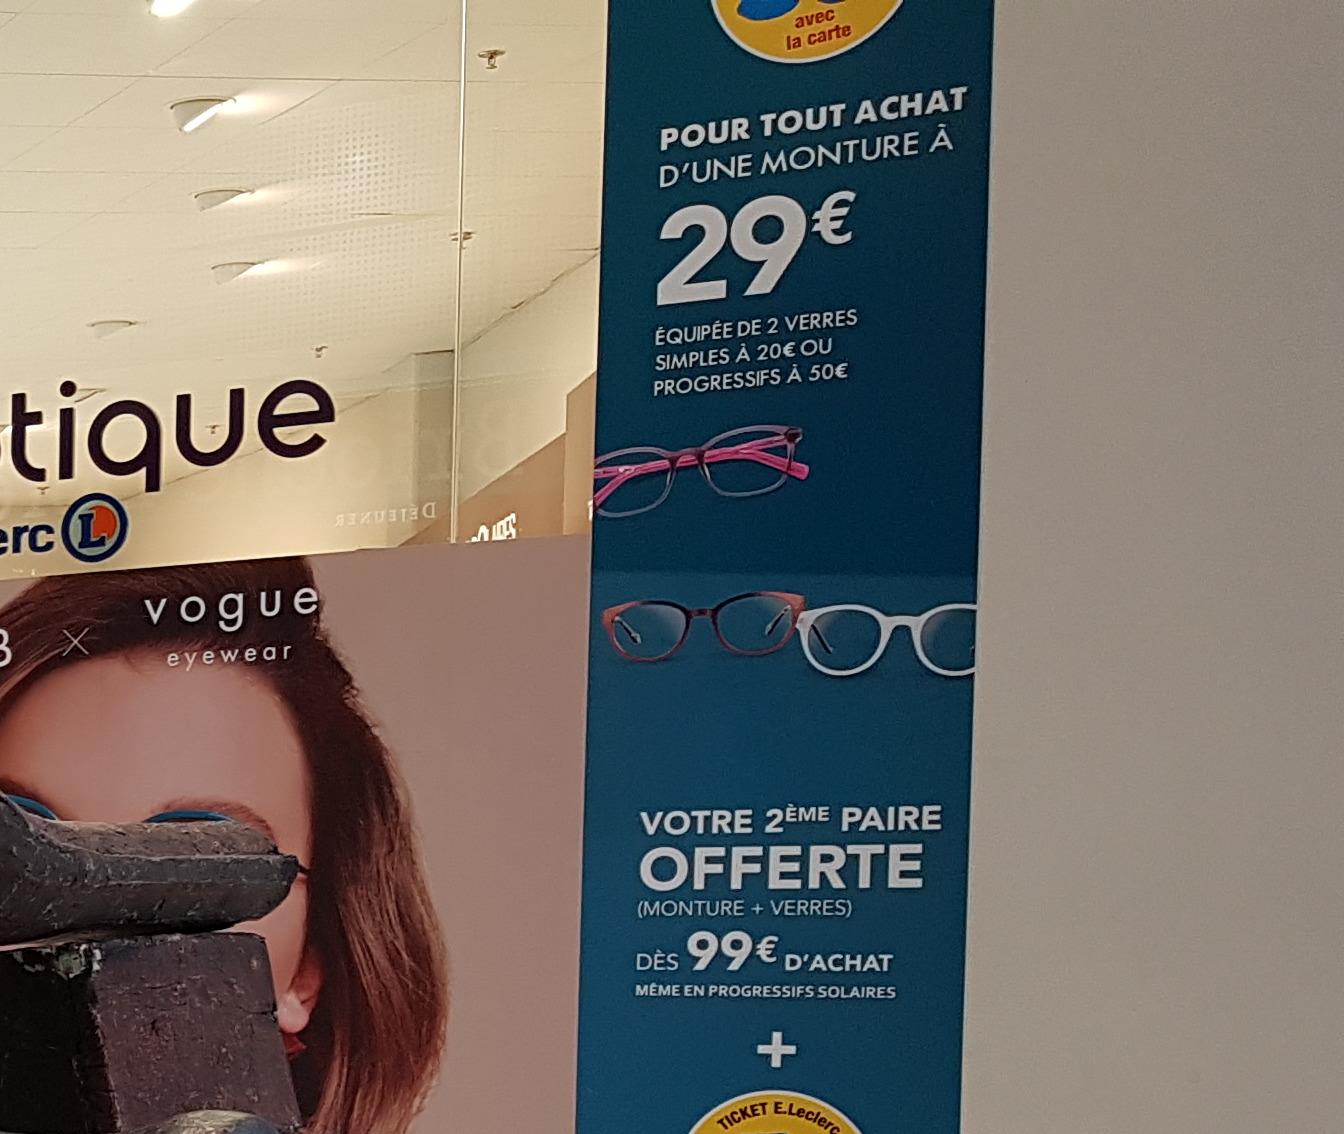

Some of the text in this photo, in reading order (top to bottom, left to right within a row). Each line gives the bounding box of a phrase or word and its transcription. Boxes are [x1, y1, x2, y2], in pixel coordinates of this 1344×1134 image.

[794, 8, 835, 30] avec
[786, 22, 852, 51] la carte
[659, 86, 969, 151] POUR TOUT ACHAT
[760, 131, 919, 175] MONTURE
[928, 124, 954, 153] À
[656, 190, 856, 306] 29€
[654, 308, 858, 347] ÉQUIPÉE DE 2 VERRES
[654, 338, 833, 371] SIMPLES À 20€ OU
[653, 362, 849, 397] PROGRESSIFS À 50€
[144, 587, 320, 633] vogue
[167, 642, 292, 672] eyewear
[640, 808, 753, 836] VOTRE
[841, 804, 942, 832] PAIRE
[639, 843, 924, 892] OFFERTE
[637, 900, 745, 919] (MONTURE
[770, 898, 853, 919] VERRES)
[635, 951, 679, 972] DÈS
[686, 930, 779, 972] 99€
[635, 982, 897, 999] MÊME EN PROGRESSIFS SOLAIRES
[716, 1102, 768, 1131] TICKET
